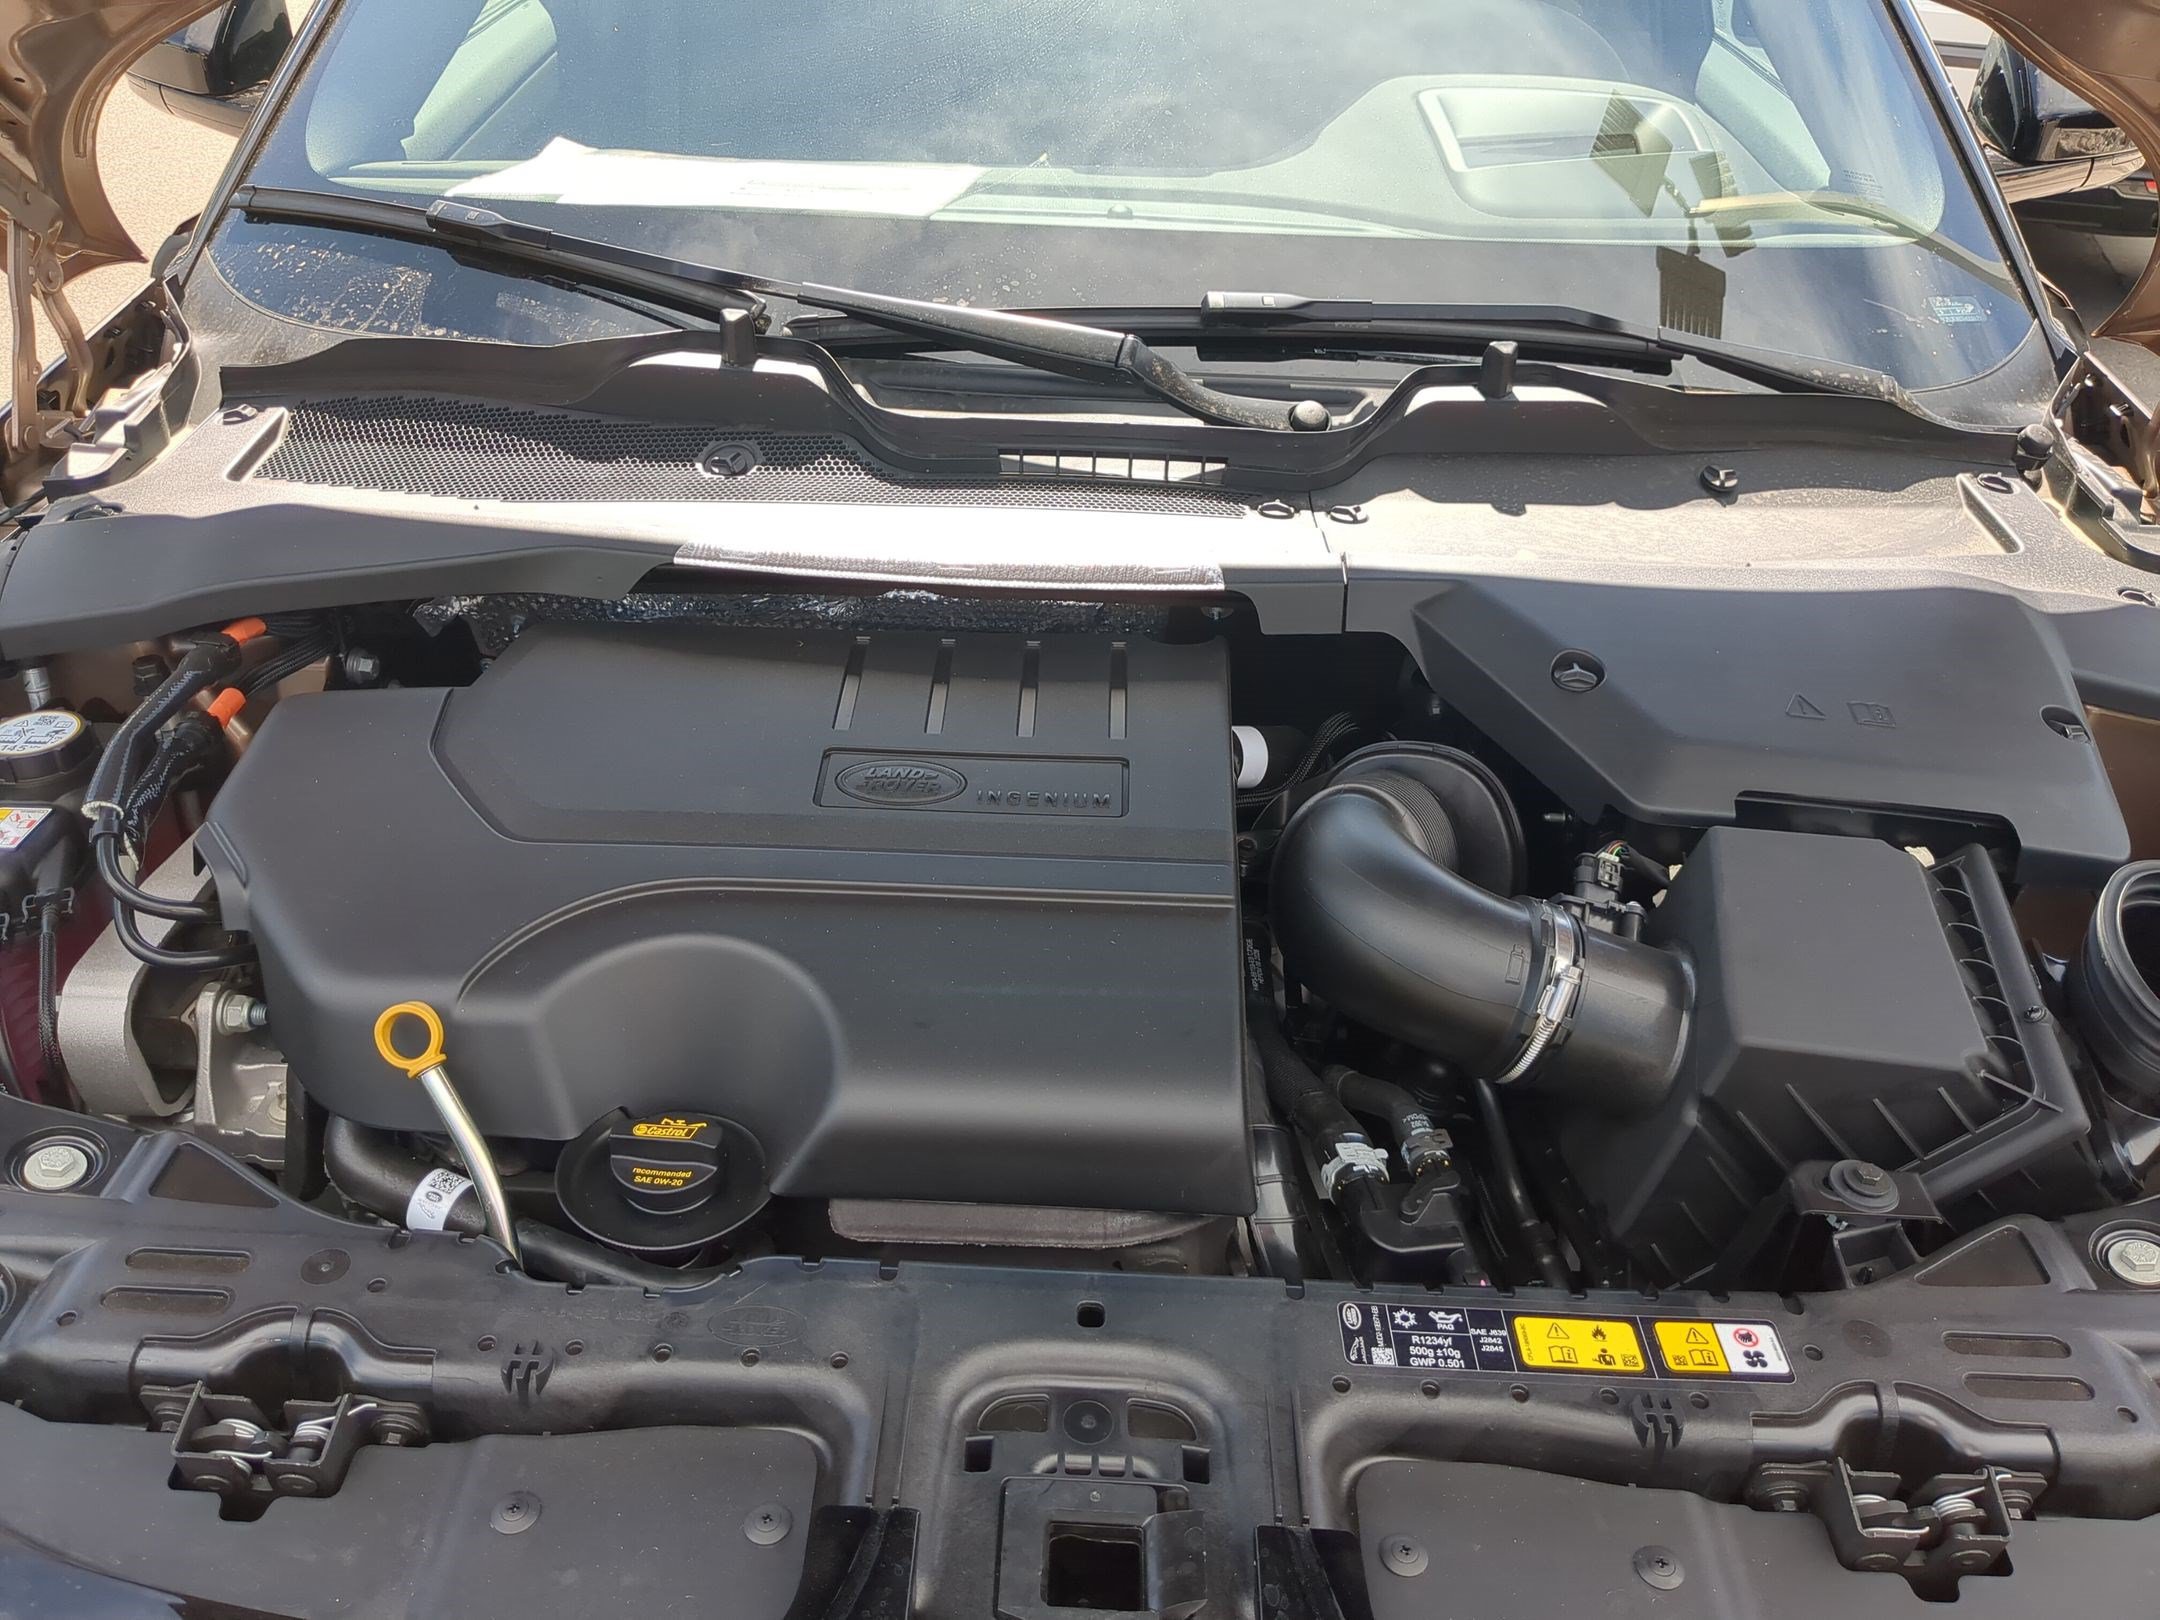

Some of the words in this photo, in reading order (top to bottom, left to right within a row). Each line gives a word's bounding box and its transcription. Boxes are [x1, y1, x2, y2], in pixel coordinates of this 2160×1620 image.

[863, 766, 926, 780] LAND
[976, 790, 1112, 809] INGENIUM
[647, 1126, 688, 1137] Castrol
[633, 1167, 692, 1178] recommended
[634, 1175, 652, 1183] SAE
[654, 1177, 683, 1186] 0W-20
[1411, 1335, 1452, 1347] R1234yf
[1409, 1346, 1435, 1358] 500g
[1409, 1357, 1436, 1367] GWP
[1437, 1358, 1465, 1368] 0.501
